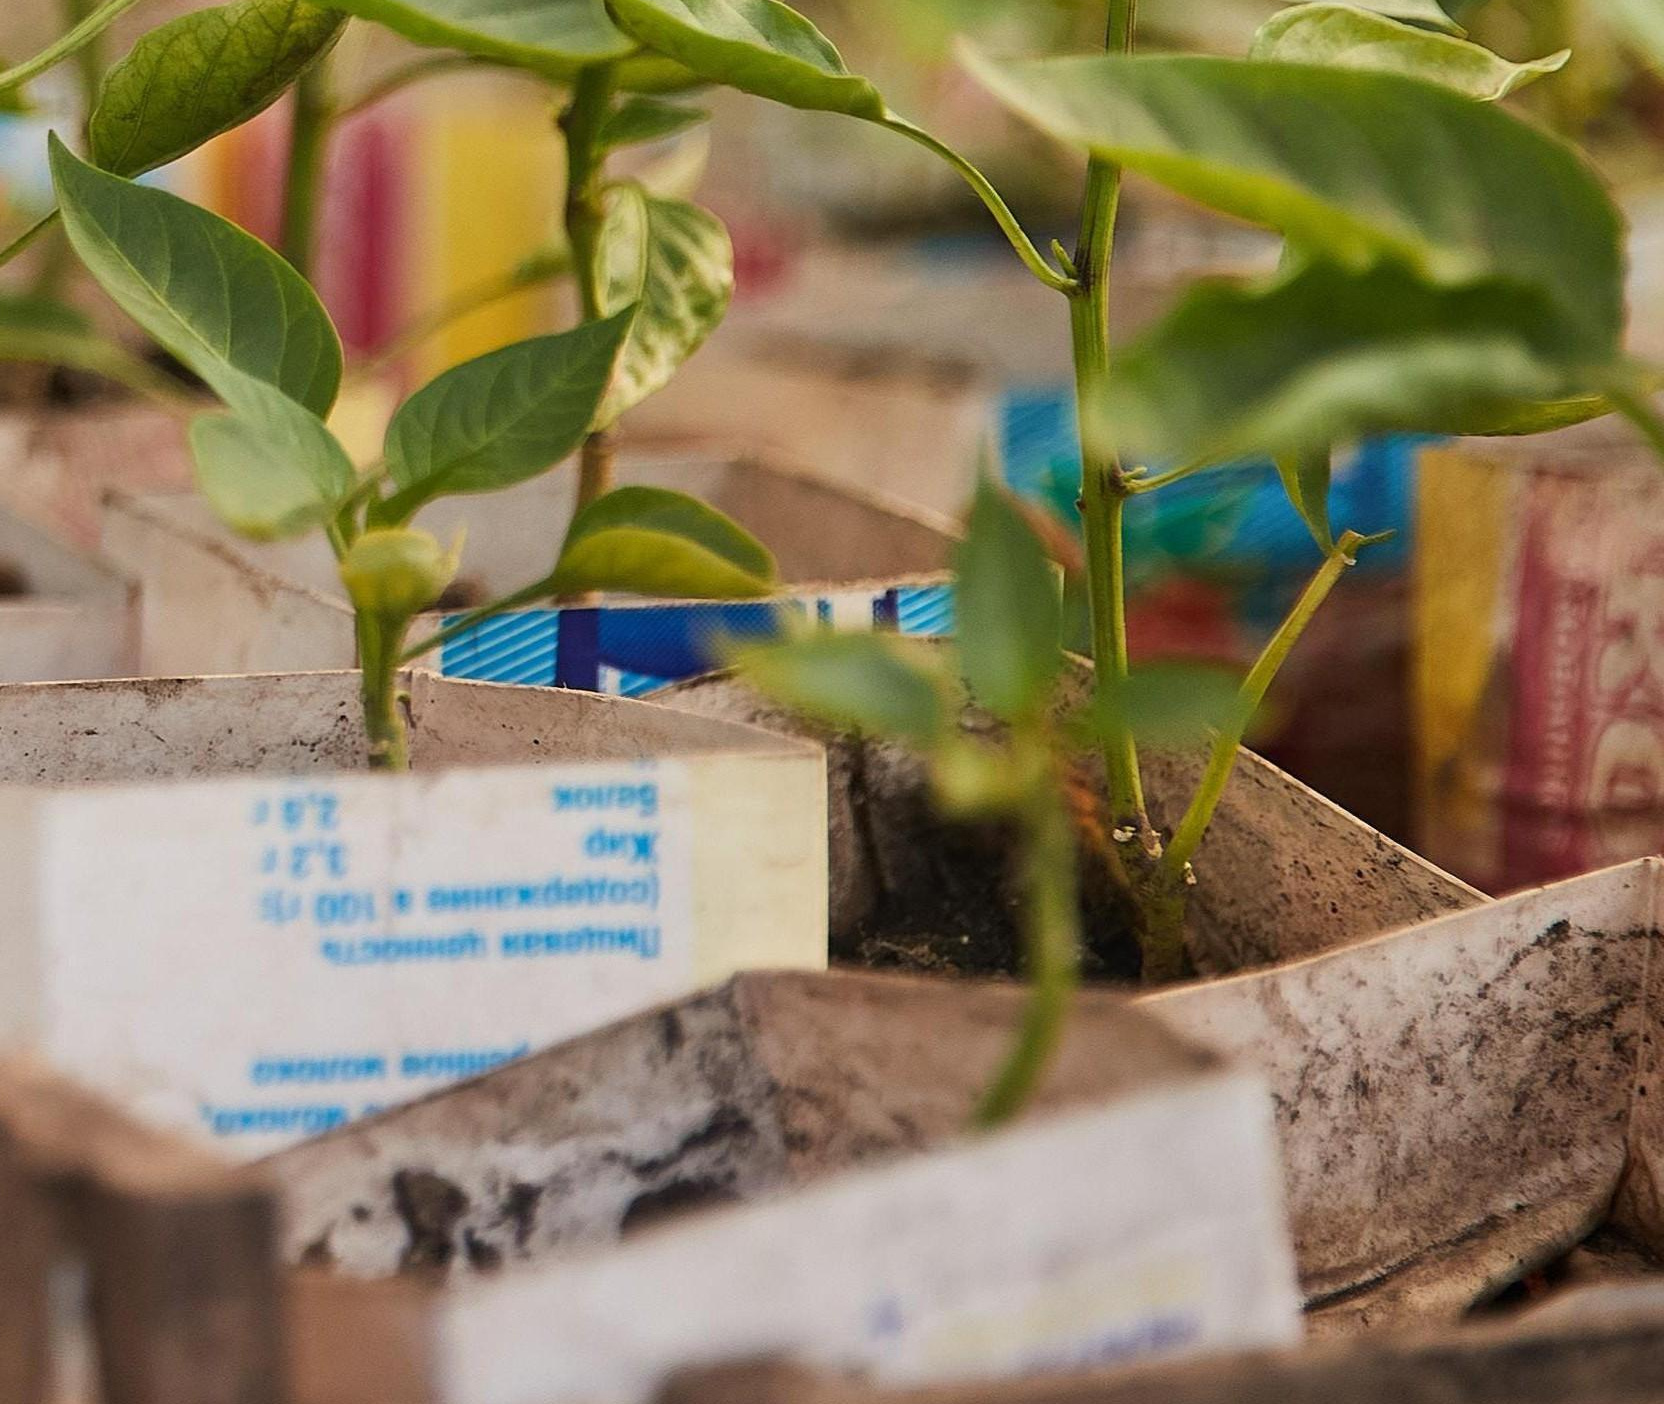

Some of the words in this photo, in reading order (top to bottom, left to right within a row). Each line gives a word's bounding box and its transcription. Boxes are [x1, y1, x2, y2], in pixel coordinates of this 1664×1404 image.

[552, 781, 658, 816] Белок
[583, 828, 659, 865] Жир
[313, 892, 377, 926] 100
[394, 888, 413, 914] в
[427, 874, 660, 911] (содержание
[321, 928, 486, 965] ценность
[501, 925, 661, 960] Пищевая
[250, 1055, 386, 1085] молоко
